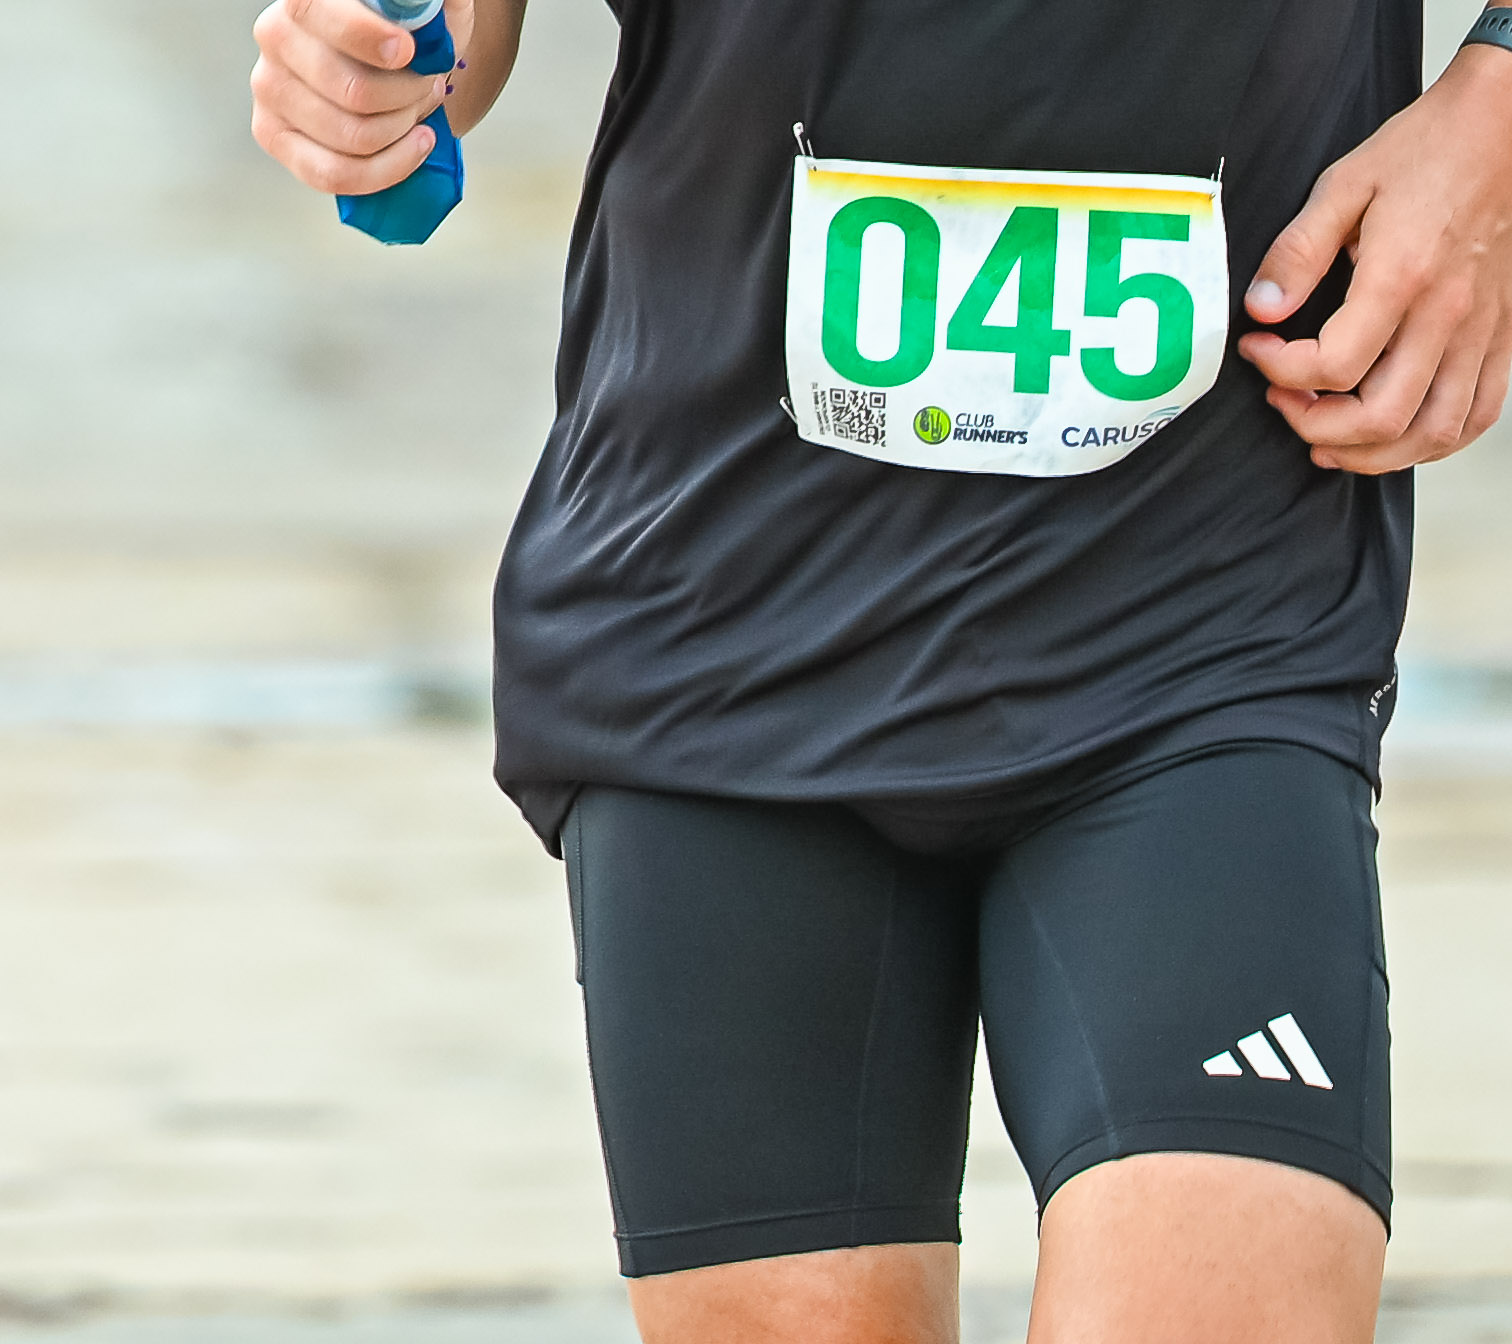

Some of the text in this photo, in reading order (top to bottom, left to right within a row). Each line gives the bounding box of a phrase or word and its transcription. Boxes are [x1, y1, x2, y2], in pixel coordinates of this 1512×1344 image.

[821, 196, 1194, 402] 045
[955, 412, 994, 428] CLUB
[952, 427, 1028, 444] RUNNER'S
